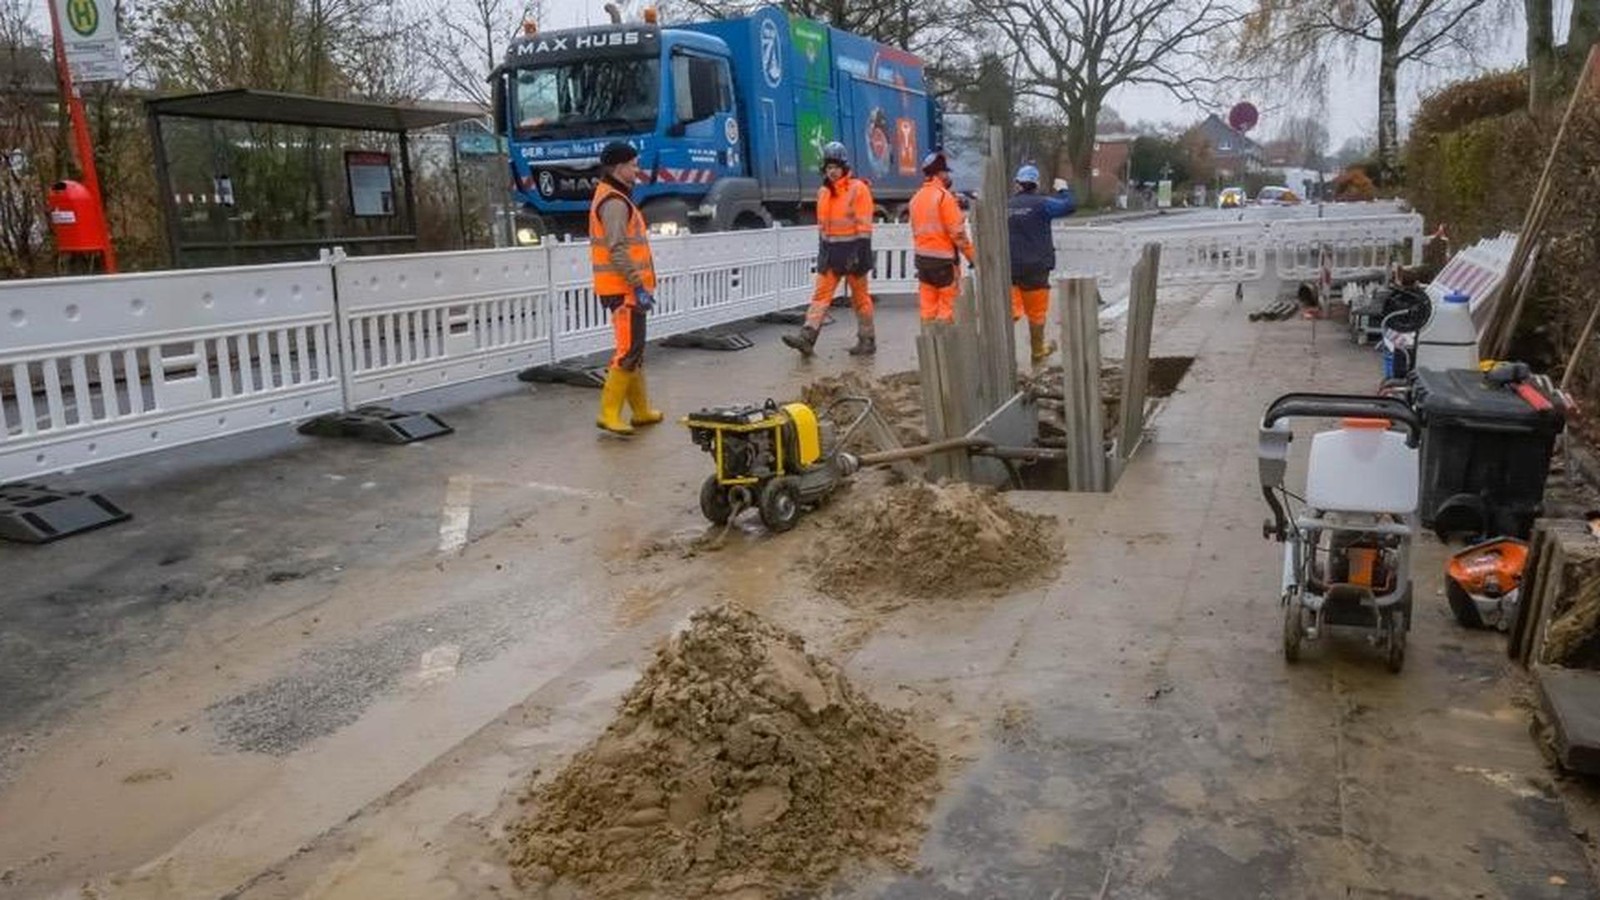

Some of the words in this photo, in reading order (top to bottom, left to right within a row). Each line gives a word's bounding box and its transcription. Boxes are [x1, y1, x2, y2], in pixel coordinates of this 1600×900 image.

[73, 1, 91, 27] H
[518, 37, 568, 56] MAX
[576, 32, 639, 49] HUSS
